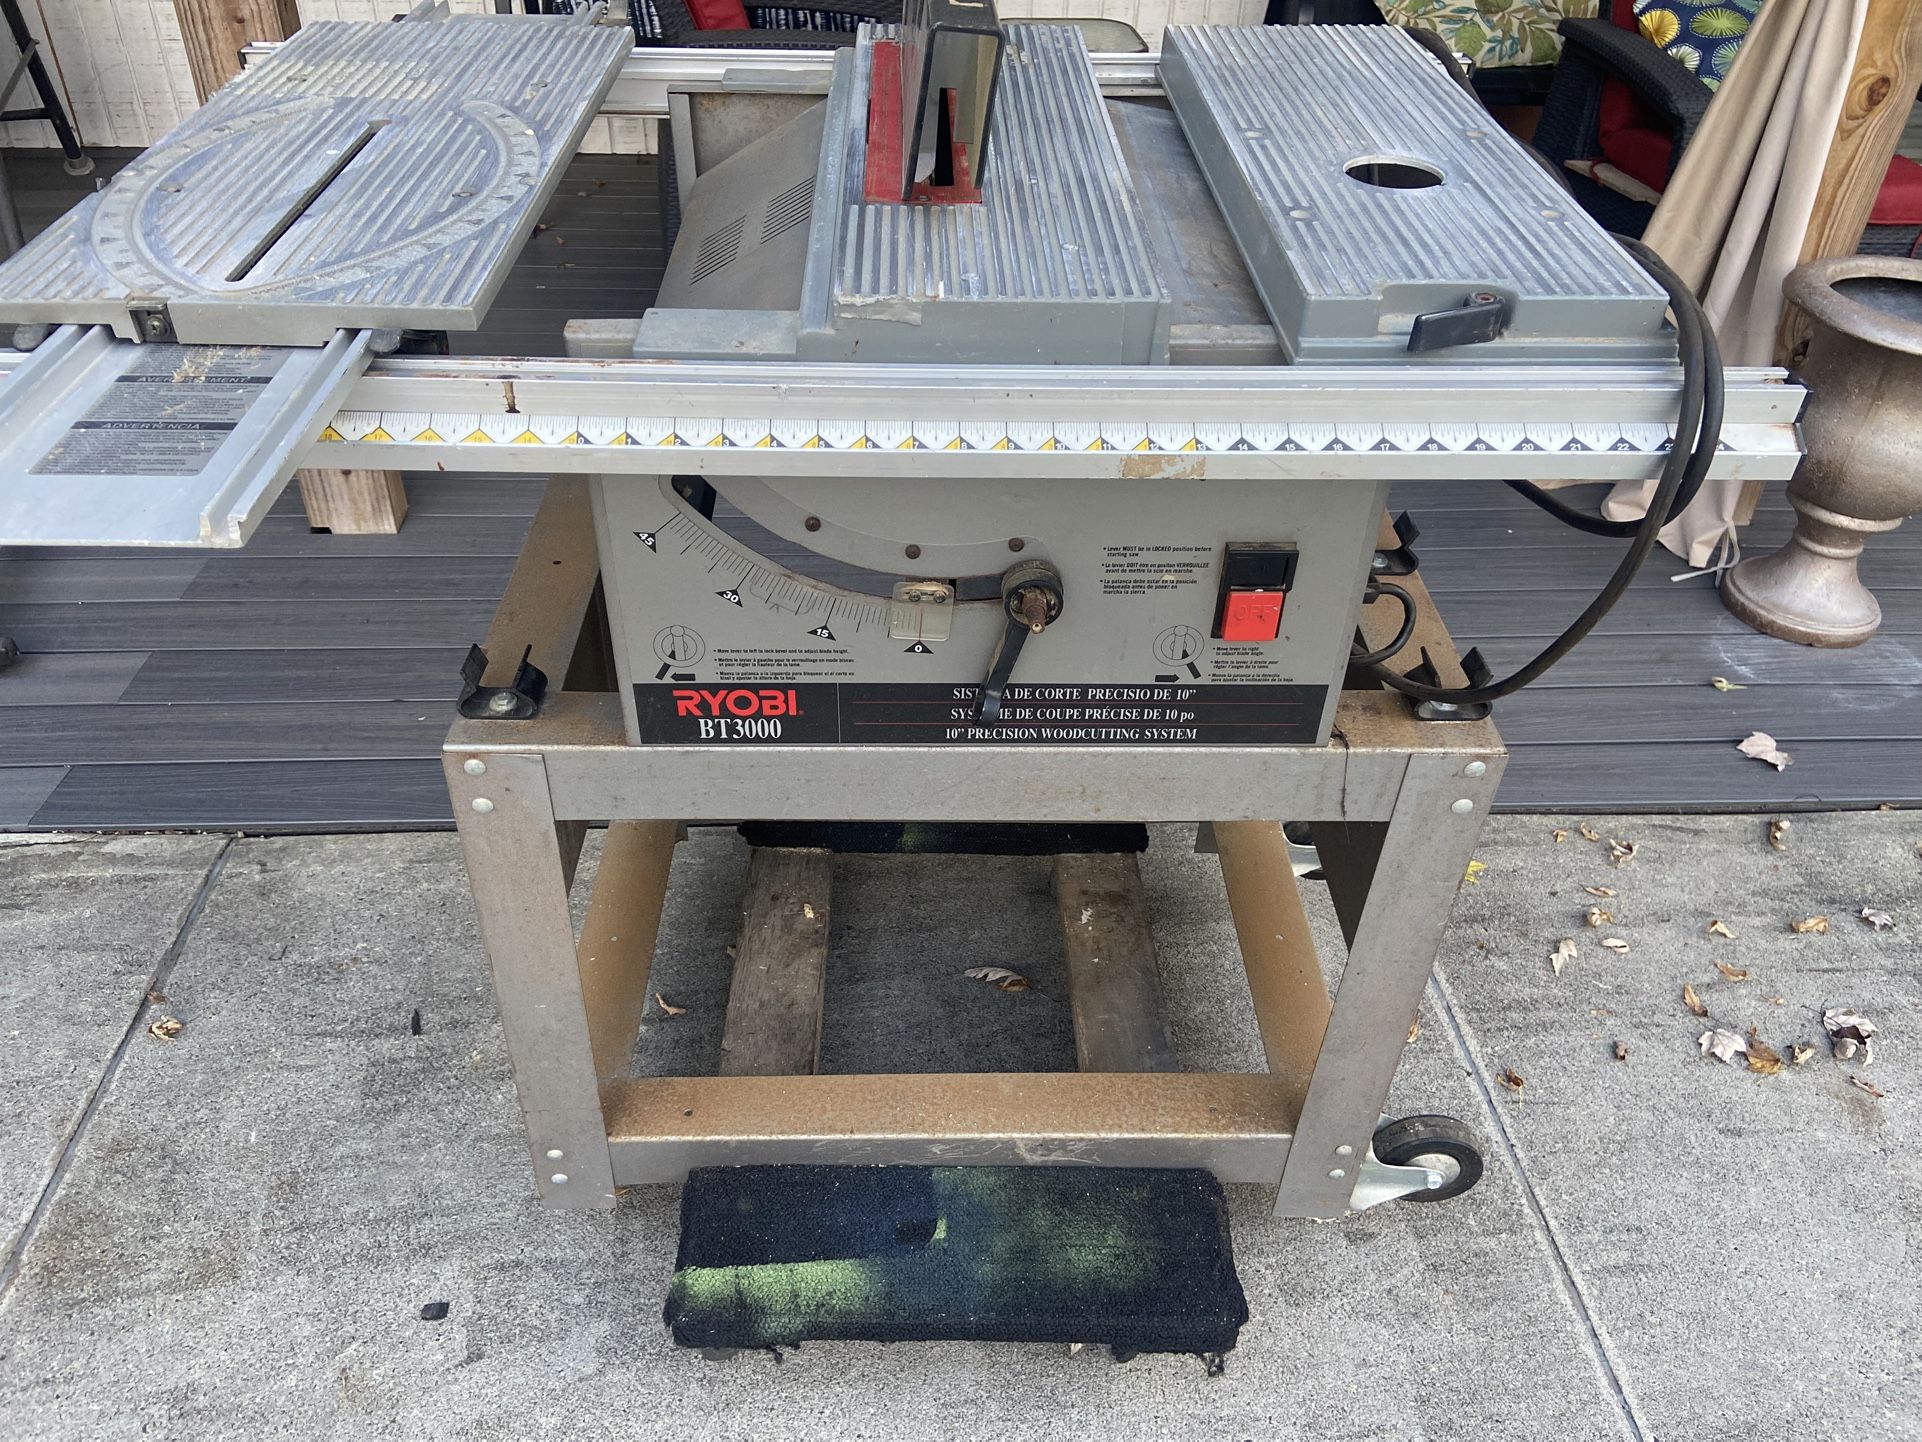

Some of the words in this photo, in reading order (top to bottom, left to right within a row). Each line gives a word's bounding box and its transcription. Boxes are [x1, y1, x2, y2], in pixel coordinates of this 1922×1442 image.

[639, 533, 654, 545] 45
[723, 591, 739, 603] 30
[1234, 604, 1276, 620] OFF
[816, 628, 829, 638] 15
[953, 688, 1011, 700] SISTA
[1015, 688, 1032, 700] DE
[1036, 688, 1081, 700] CORTE
[1088, 688, 1150, 700] PRECISIO
[1153, 688, 1171, 700] DE
[672, 690, 797, 716] RYOBI
[951, 708, 1012, 719] SYSE
[1016, 708, 1033, 719] DE
[1036, 708, 1082, 720] COUPE
[1084, 706, 1140, 720] PRÉCISE
[1143, 709, 1161, 720] DE
[1165, 709, 1177, 720] 10
[1180, 711, 1194, 722] po
[698, 718, 782, 739] BT3000
[967, 728, 1038, 739] PRECISION
[1041, 728, 1139, 739] WOODCUTTING
[1144, 728, 1198, 739] SYSTEM
